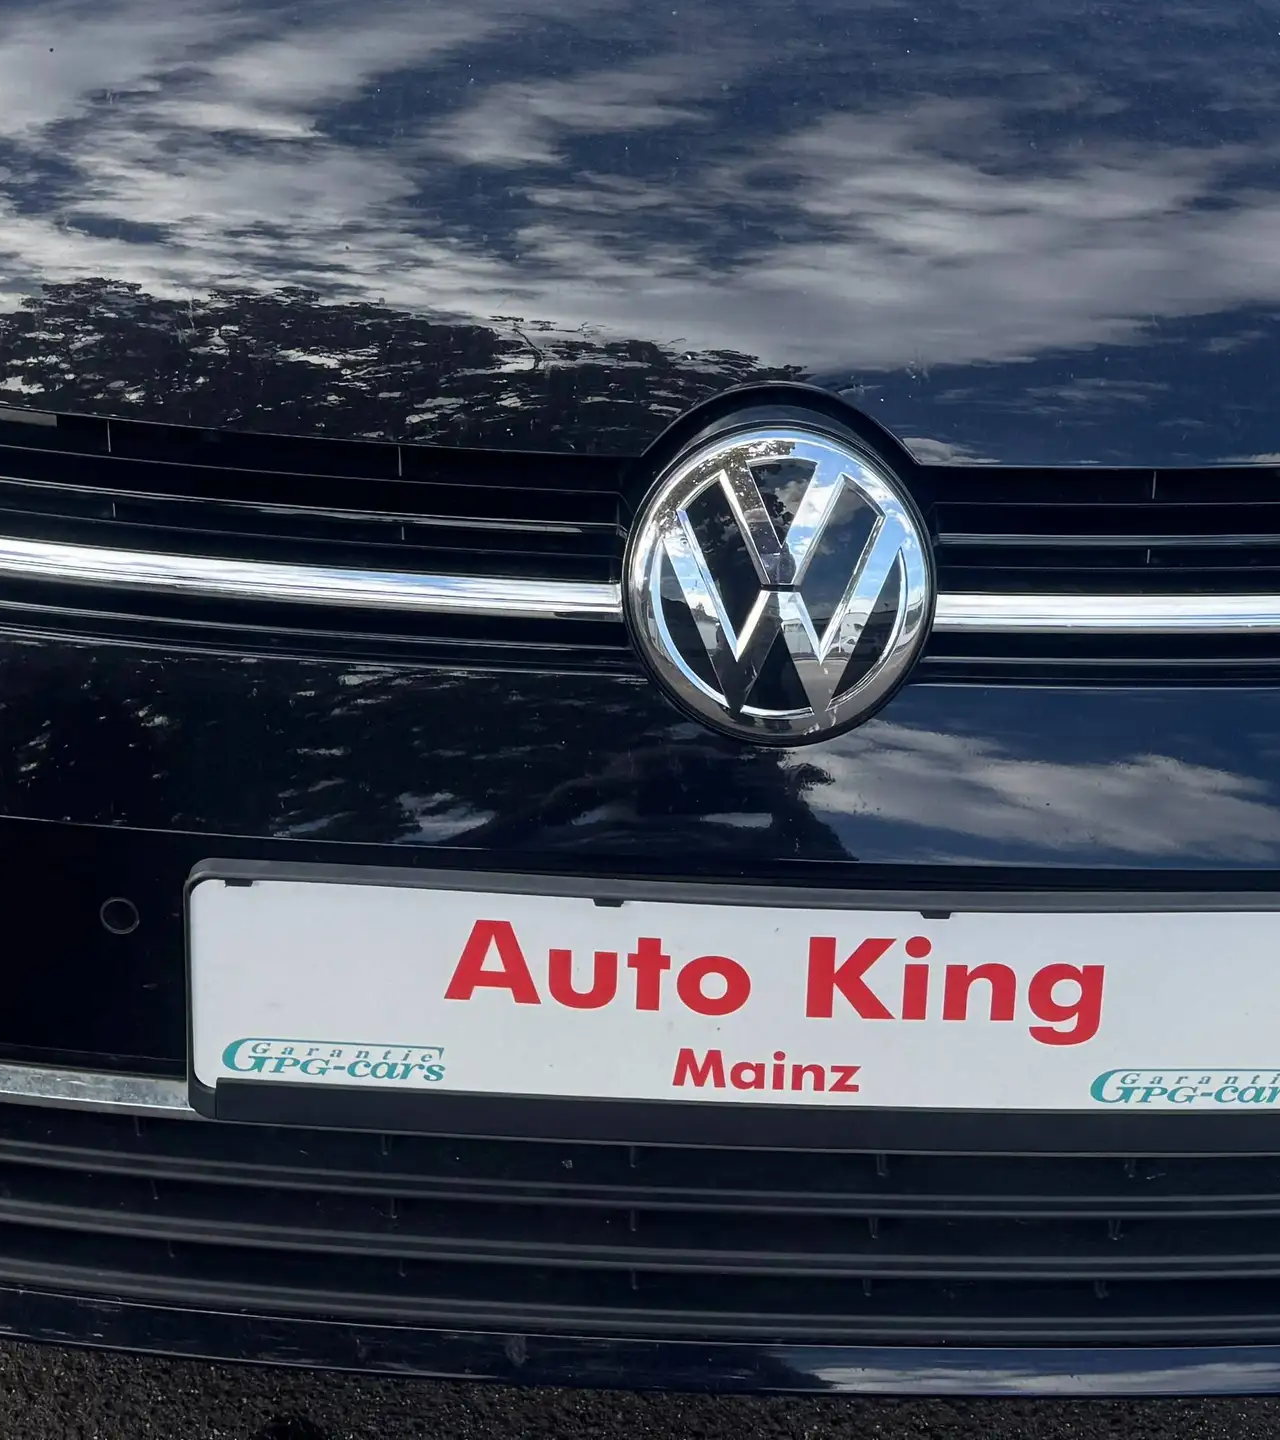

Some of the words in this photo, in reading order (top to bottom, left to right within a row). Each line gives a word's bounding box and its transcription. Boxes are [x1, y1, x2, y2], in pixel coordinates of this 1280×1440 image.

[444, 919, 751, 1016] Auto
[805, 936, 1105, 1046] King
[251, 1042, 433, 1062] Garantie
[672, 1047, 860, 1093] Mainz
